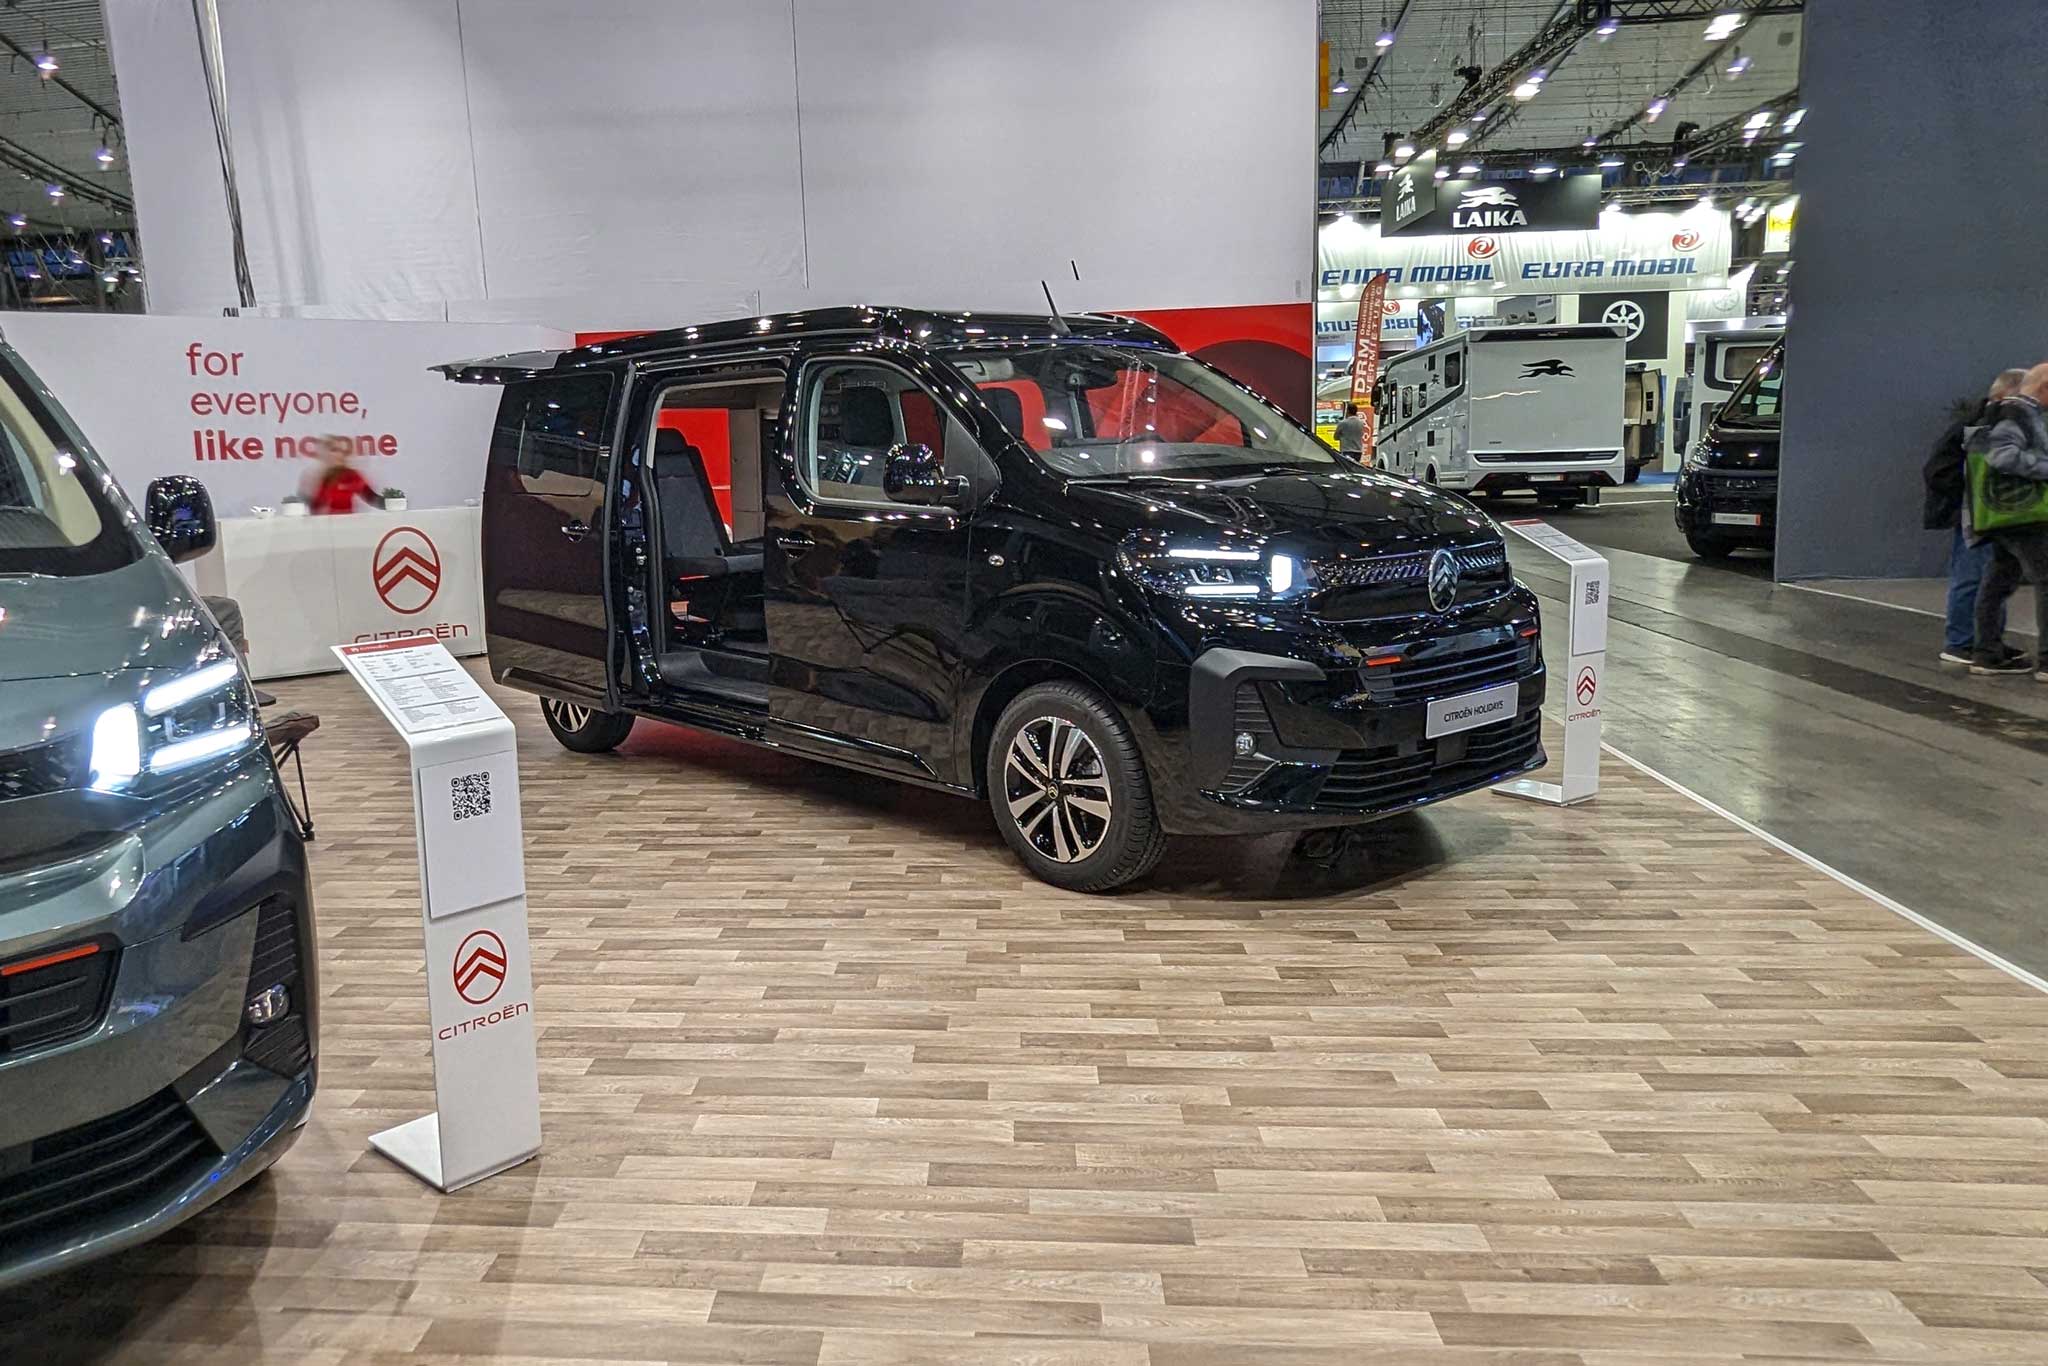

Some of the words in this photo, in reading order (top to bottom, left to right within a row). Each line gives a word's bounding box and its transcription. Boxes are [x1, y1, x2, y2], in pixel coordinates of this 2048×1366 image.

[1396, 196, 1416, 221] LAIKA
[1453, 210, 1528, 228] LAIKA
[1410, 264, 1494, 282] MOBIL
[1522, 261, 1605, 280] EURA
[1611, 257, 1697, 277] MOBIL
[1365, 286, 1383, 393] VERMIETUNG
[186, 342, 244, 376] for
[1354, 338, 1371, 393] DRM
[190, 391, 368, 424] everyone,
[193, 429, 264, 461] like
[1443, 706, 1473, 722] CITROËN
[1474, 700, 1504, 716] HOLIDAYS
[438, 1002, 529, 1041] CITROËN
